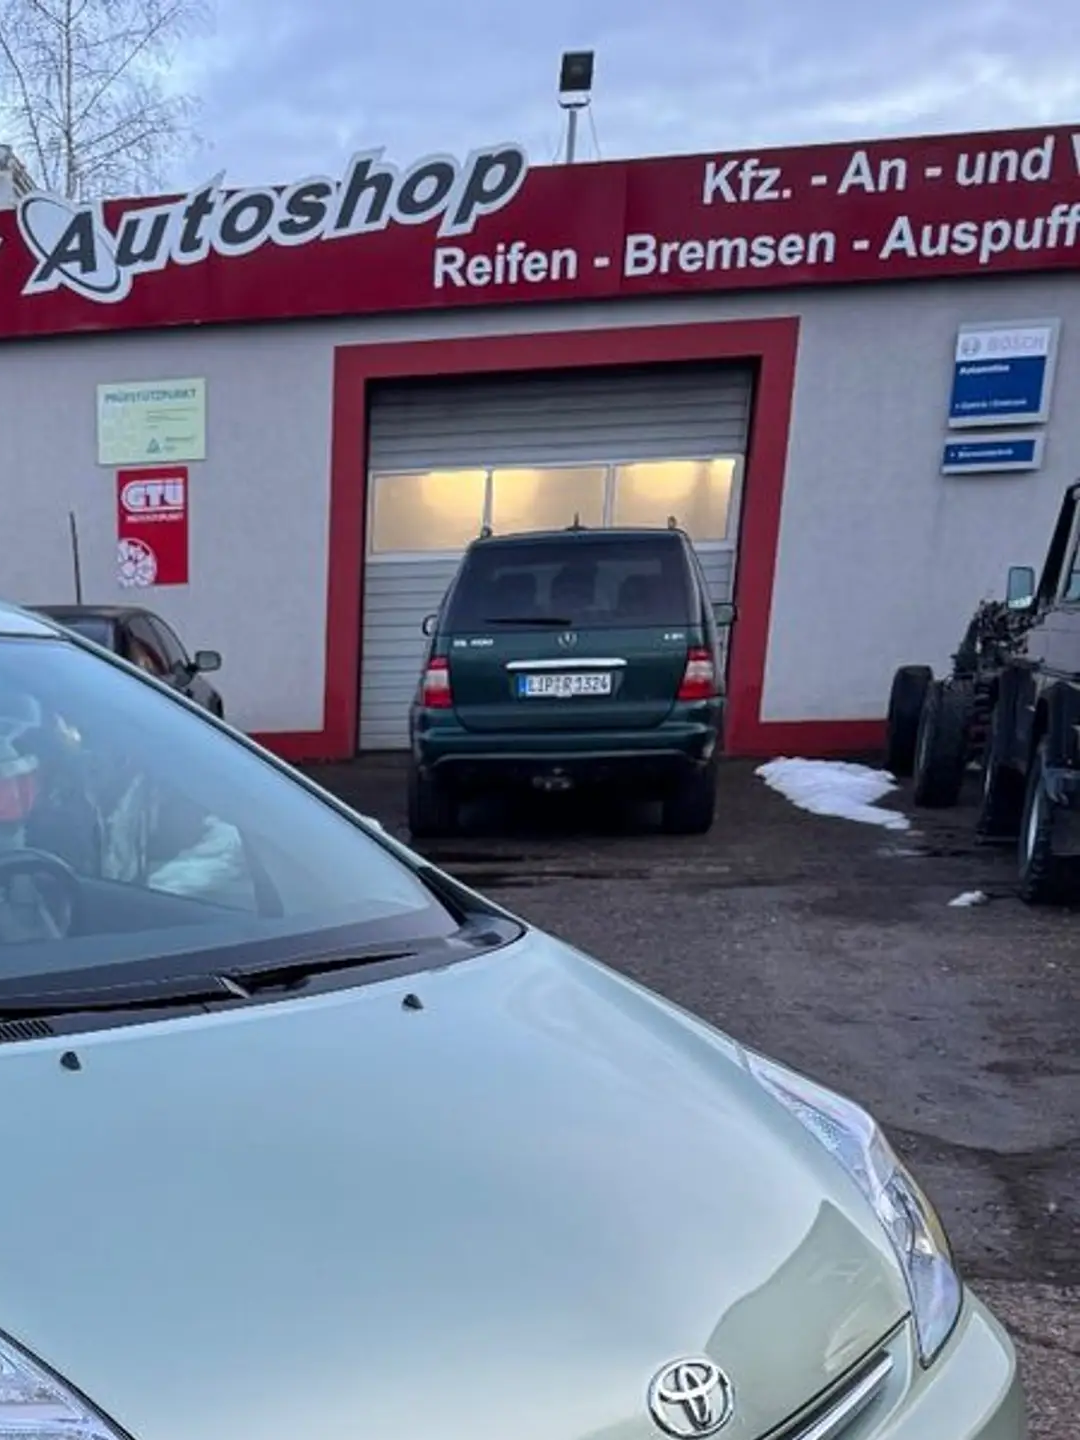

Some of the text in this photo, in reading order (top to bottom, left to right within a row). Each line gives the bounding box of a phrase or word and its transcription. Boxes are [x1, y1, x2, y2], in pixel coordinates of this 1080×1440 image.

[702, 157, 792, 205] Kfz.
[836, 150, 907, 195] An
[956, 134, 1056, 186] und
[21, 143, 528, 300] Autoshop
[434, 240, 578, 289] Reifen
[624, 230, 837, 277] Bremsen
[878, 202, 1080, 265] Auspuff
